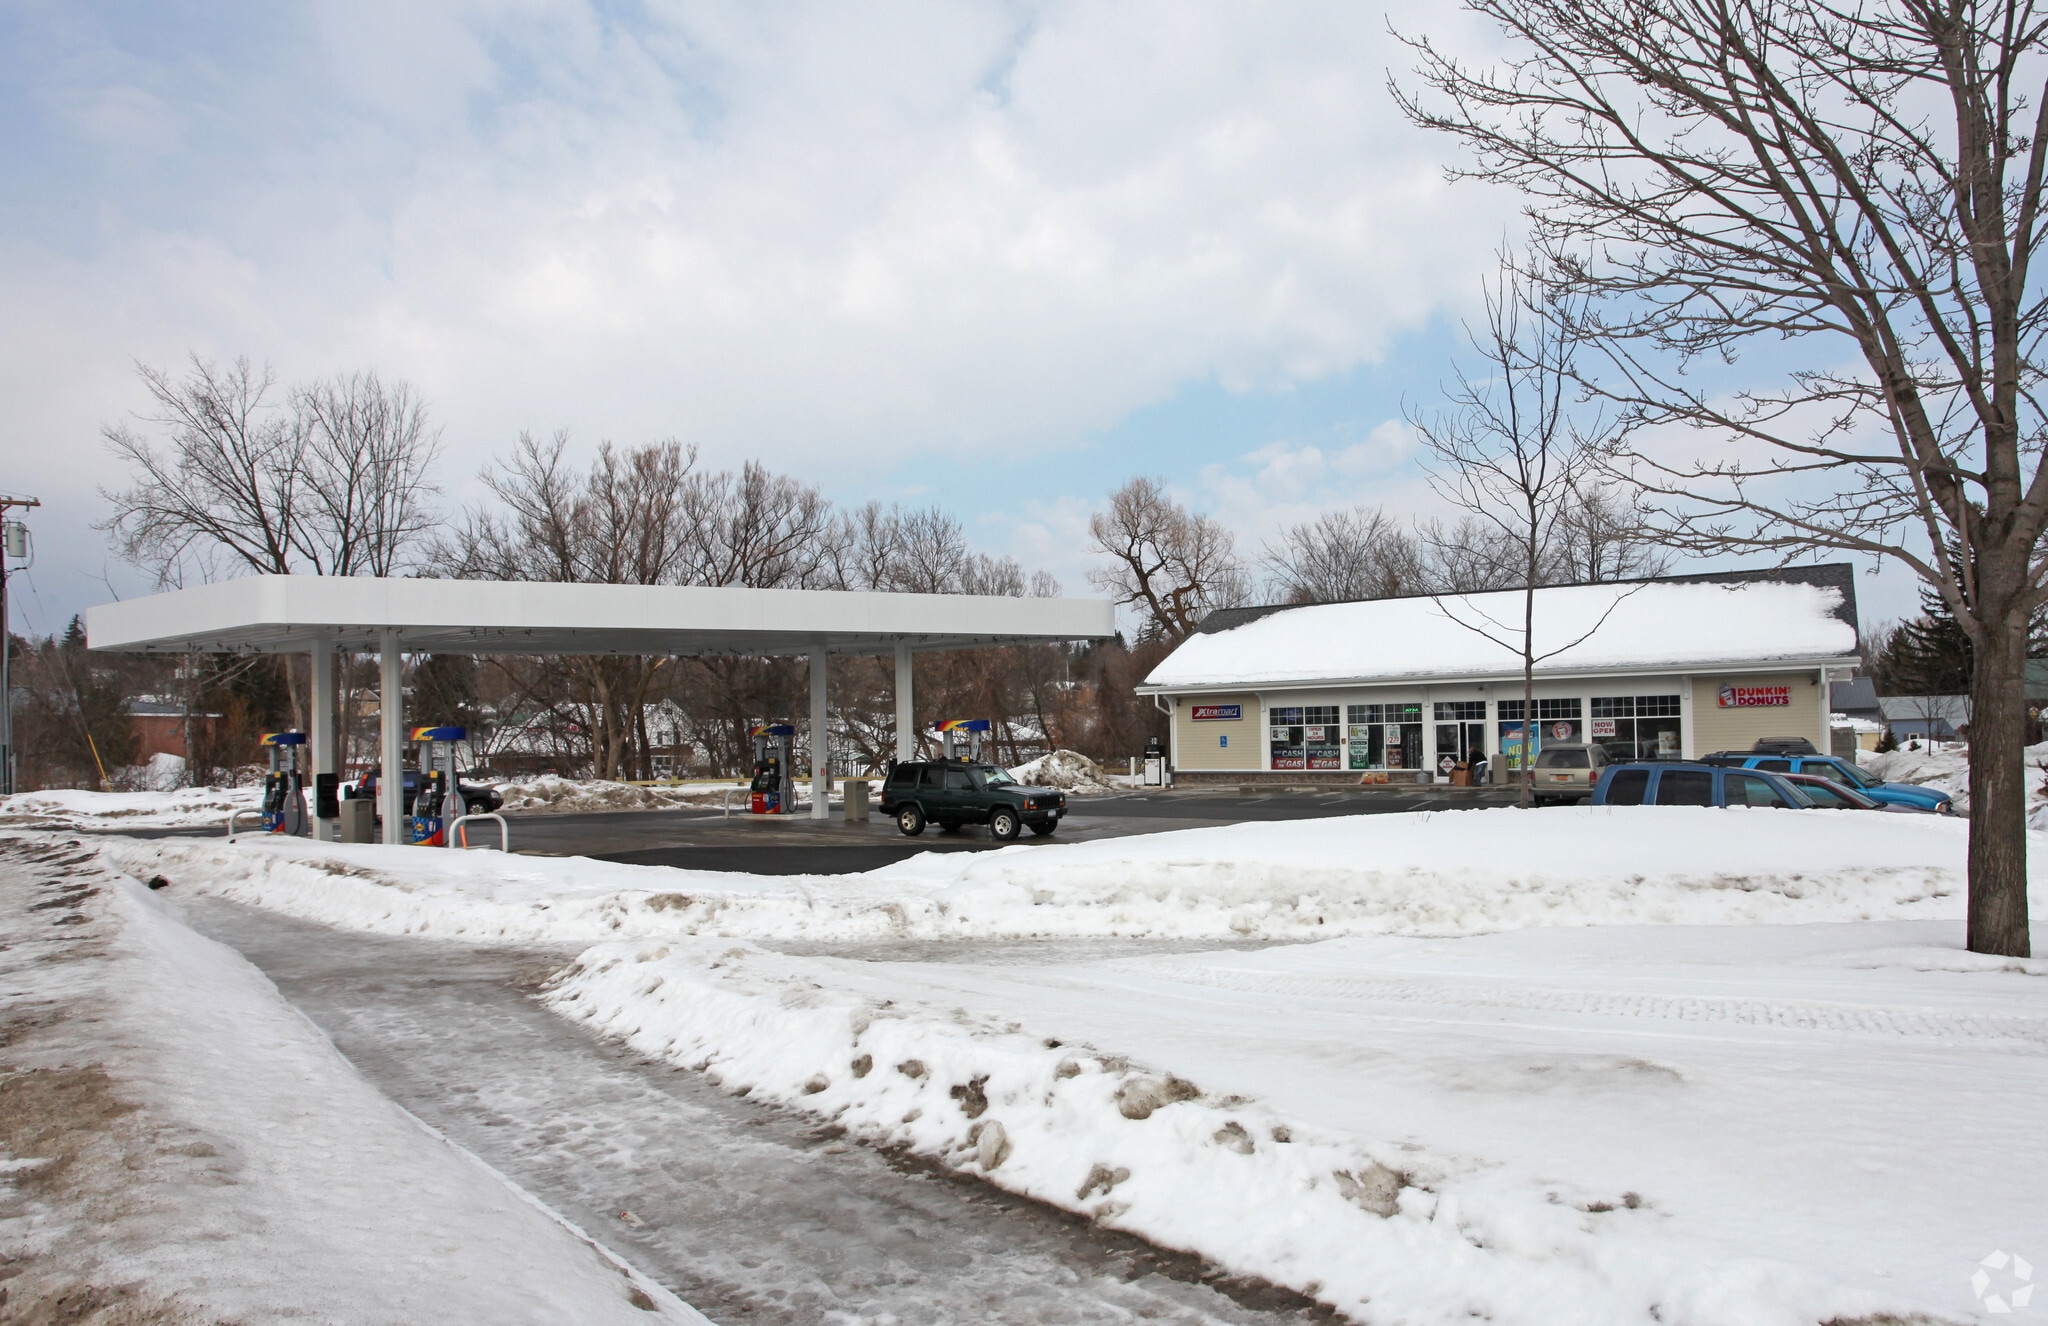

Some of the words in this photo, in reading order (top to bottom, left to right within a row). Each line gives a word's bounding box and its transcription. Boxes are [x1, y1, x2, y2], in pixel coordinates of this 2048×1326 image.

[1737, 686, 1791, 697] DUNKIN'
[1738, 696, 1789, 706] DONUTS
[1194, 707, 1238, 717] Xtramart
[1282, 749, 1304, 757] CASH
[1317, 749, 1339, 757] CASH
[1322, 760, 1340, 768] GAS!
[1507, 754, 1536, 768] OPN
